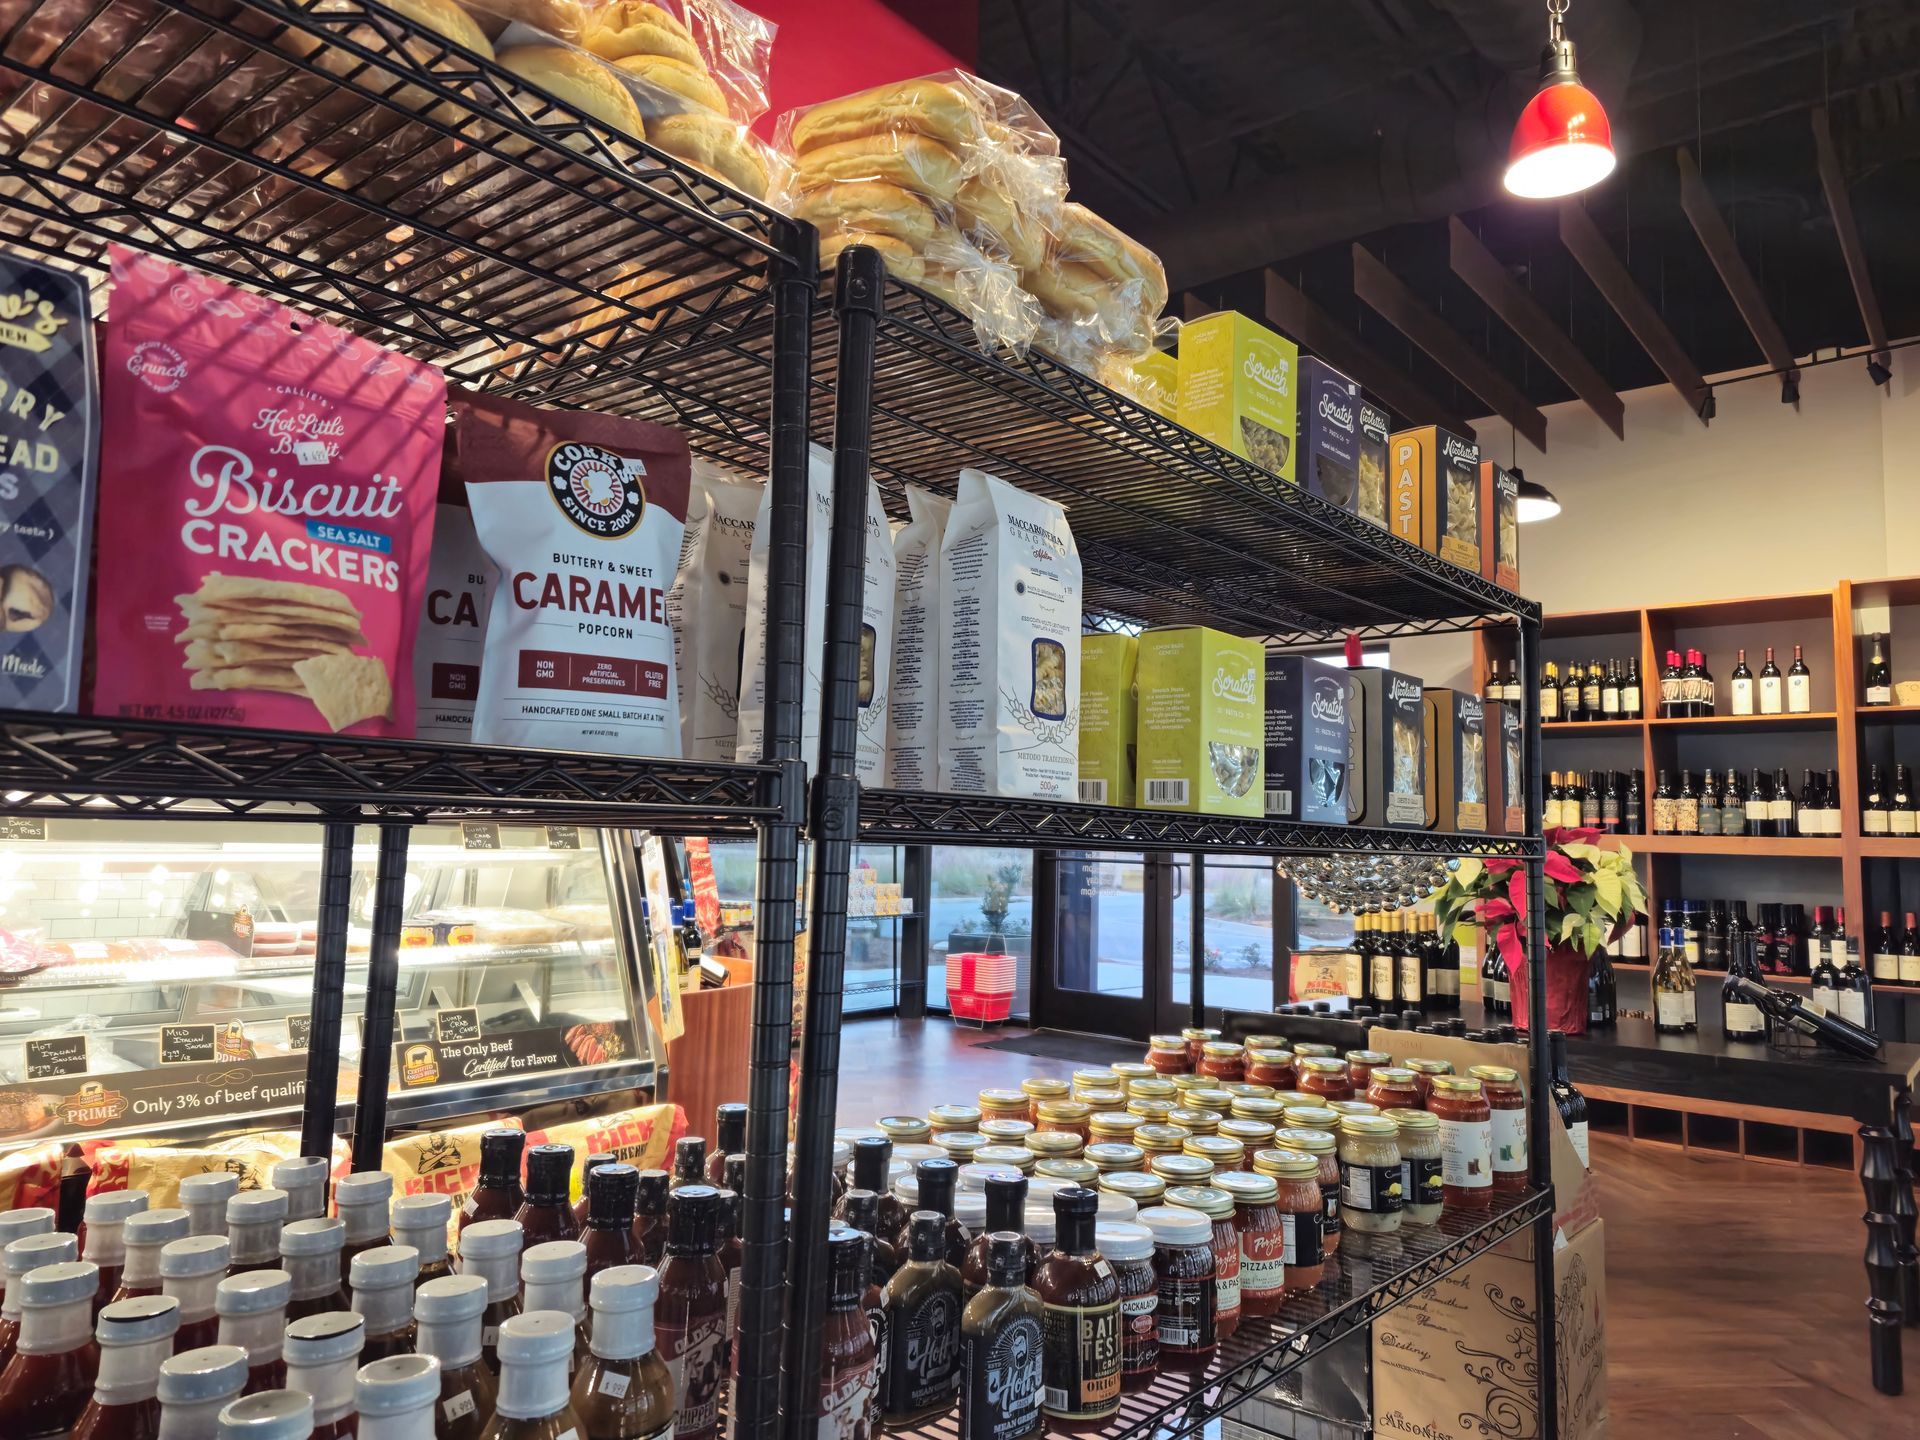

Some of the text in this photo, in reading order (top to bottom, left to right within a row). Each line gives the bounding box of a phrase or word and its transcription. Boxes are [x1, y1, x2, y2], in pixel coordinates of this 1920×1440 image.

[126, 355, 188, 379] Crunch
[1243, 352, 1289, 397] Scratch
[276, 385, 327, 408] CALLIE'S
[1319, 393, 1354, 434] Scratch
[252, 408, 345, 440] Hot Little
[185, 444, 403, 519] Biscuit
[1398, 446, 1413, 541] PAST
[562, 496, 635, 532] SINCE 2004
[318, 525, 381, 549] SEA SALT
[1007, 514, 1064, 546] MACCARONERIA
[181, 518, 399, 592] CRACKERS
[553, 552, 653, 578] BUTTERY & SWEET
[578, 622, 633, 640] POPCORN
[2, 654, 46, 675] Made
[536, 660, 554, 669] NON
[596, 662, 613, 670] ZERO
[450, 673, 467, 682] NON
[536, 669, 554, 679] GMO
[582, 676, 626, 687] PRESERVATIVES
[589, 670, 619, 679] ARTIFICIAL
[449, 681, 467, 690] GMO
[648, 679, 662, 689] FREE
[1212, 667, 1257, 704] Scratch
[522, 705, 580, 716] HANDCRAFTED
[581, 709, 597, 717] ONE
[598, 710, 622, 719] SMALL
[622, 711, 643, 720] BATCH
[1311, 692, 1344, 726] Scratch
[1017, 752, 1041, 761] METODO
[440, 1015, 463, 1023] LUMP
[450, 1020, 469, 1029] CRAB
[31, 1042, 53, 1052] HOT
[173, 1034, 204, 1043] ITALIAN
[41, 1044, 77, 1058] ITALIAN
[440, 1039, 514, 1060] The Only Beef
[50, 1054, 86, 1064] SAUSAGE
[462, 1053, 558, 1078] Certified for Flavor
[132, 1097, 172, 1115] Only
[176, 1093, 201, 1108] 3%
[204, 1091, 223, 1106] of
[225, 1087, 258, 1103] beef
[67, 1105, 118, 1123] PRIME
[1240, 1261, 1268, 1272] PIZZA
[1269, 1261, 1275, 1270] &
[1222, 1281, 1228, 1289] &
[1416, 1313, 1448, 1332] Human
[605, 1382, 609, 1391] $
[822, 1374, 860, 1411] OLDE
[452, 1406, 457, 1416] $
[994, 1408, 1039, 1433] MEAN GREEN
